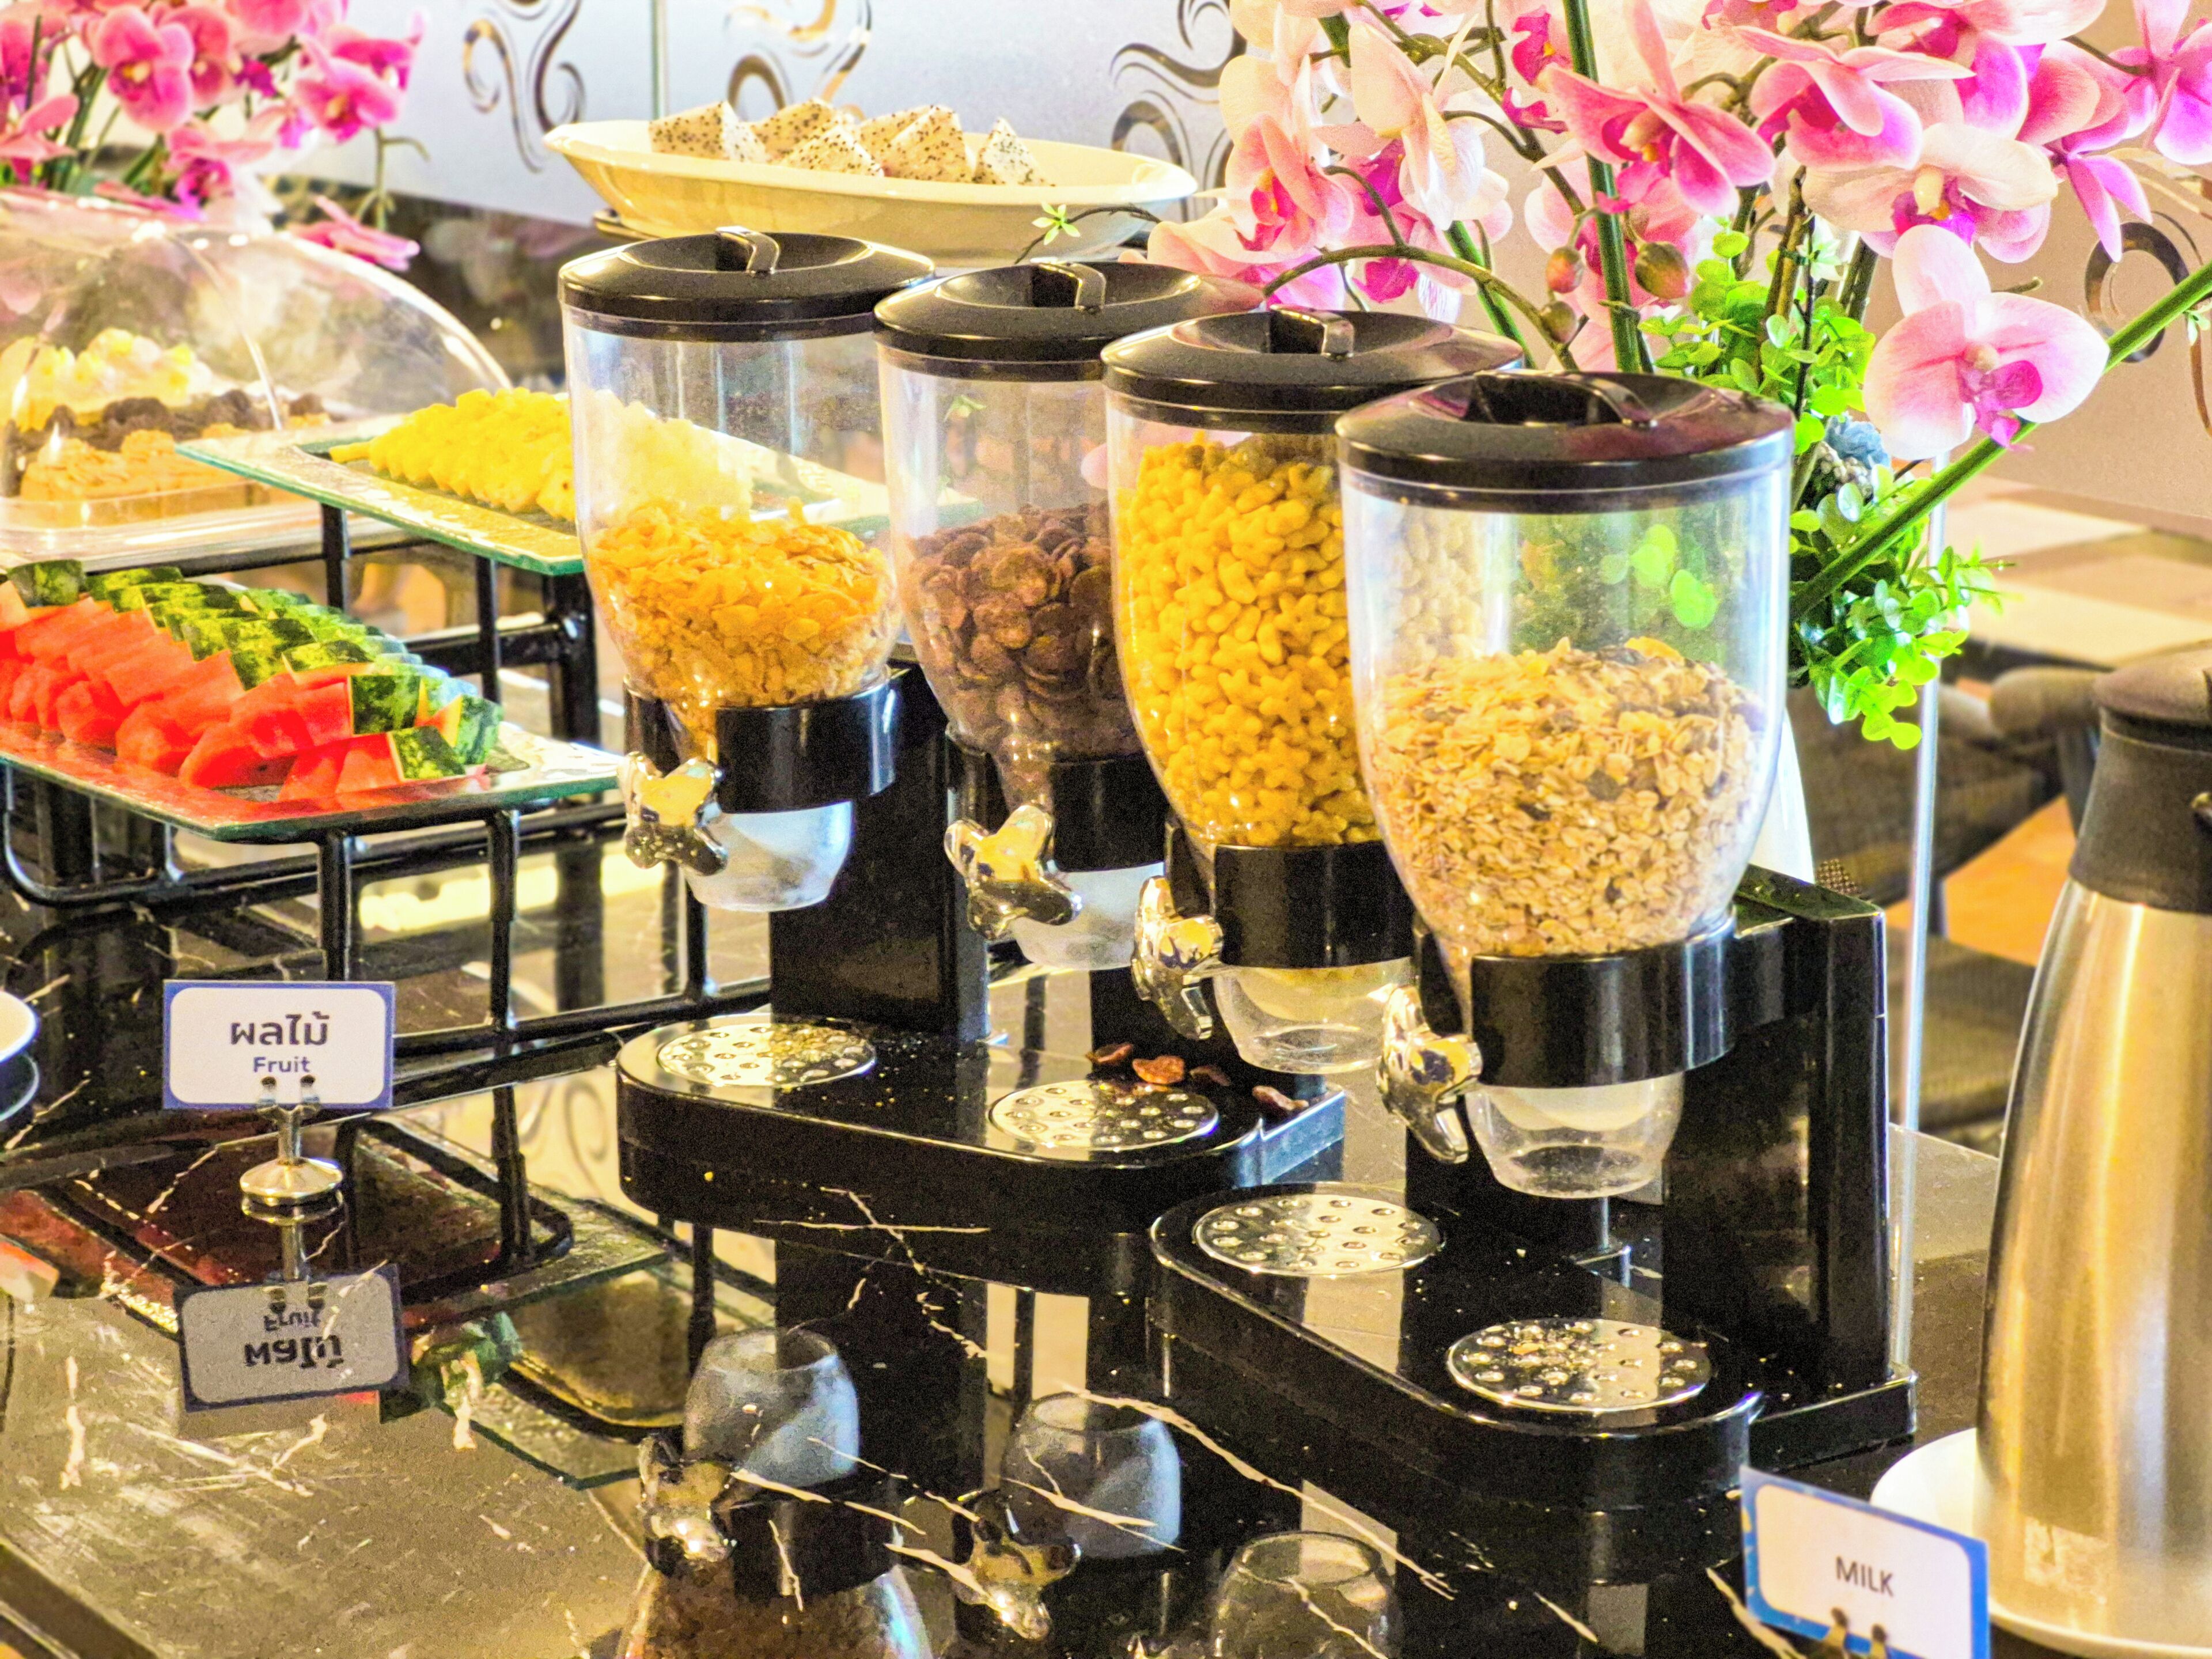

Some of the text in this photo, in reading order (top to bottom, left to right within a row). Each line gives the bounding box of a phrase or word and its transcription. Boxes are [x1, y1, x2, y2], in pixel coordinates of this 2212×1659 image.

[230, 1011, 330, 1046] ผลไม้
[253, 1056, 310, 1073] Fruit
[1835, 1556, 1895, 1597] MILK
